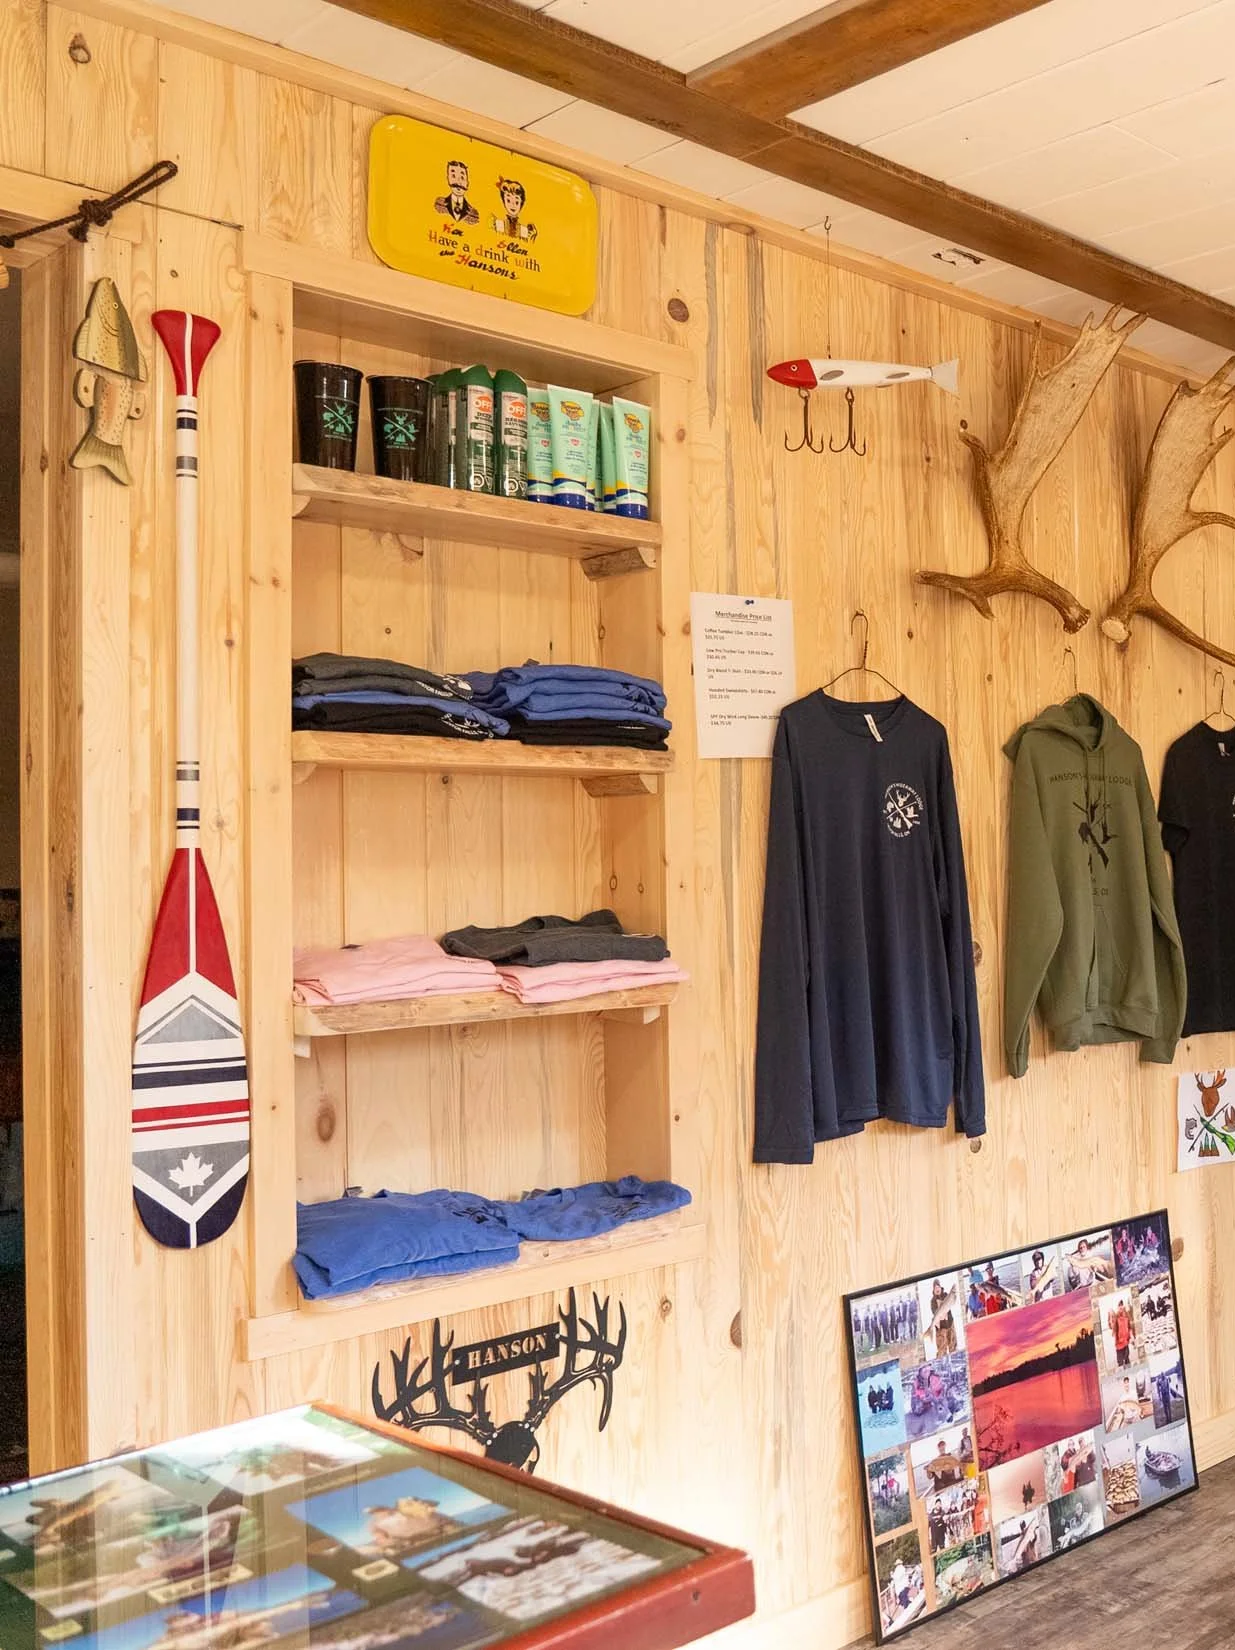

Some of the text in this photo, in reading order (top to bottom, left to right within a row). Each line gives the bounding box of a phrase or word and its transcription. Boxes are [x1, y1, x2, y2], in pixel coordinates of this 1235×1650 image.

[428, 230, 541, 273] Have a drink with
[455, 254, 520, 281] Hansons
[715, 610, 748, 619] Merchandise
[468, 1333, 547, 1370] HANSON
